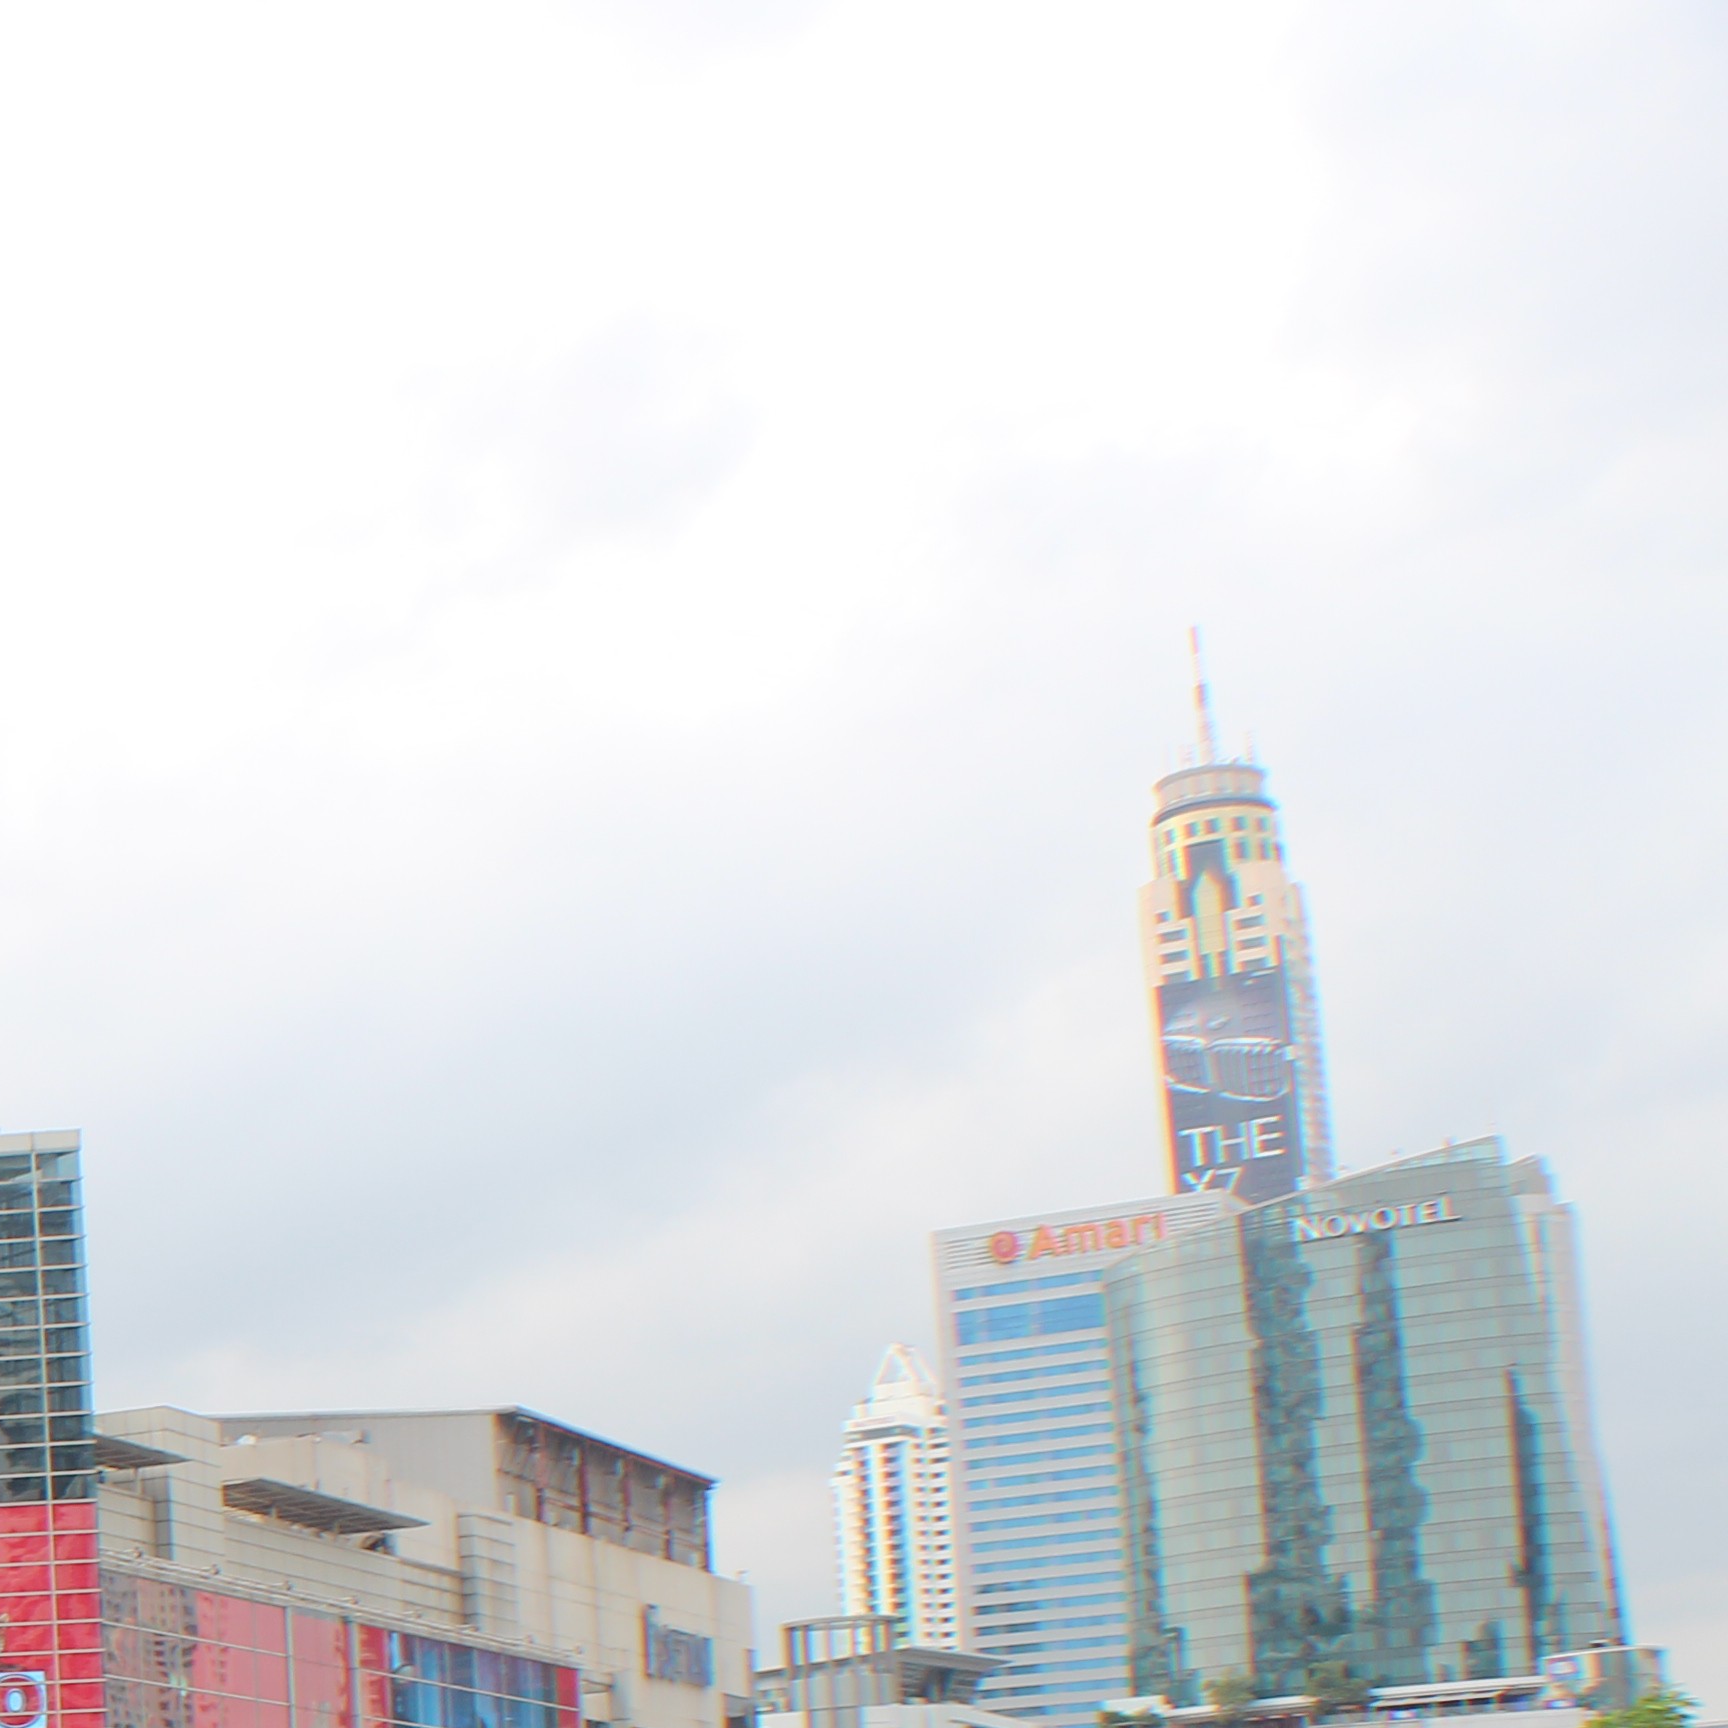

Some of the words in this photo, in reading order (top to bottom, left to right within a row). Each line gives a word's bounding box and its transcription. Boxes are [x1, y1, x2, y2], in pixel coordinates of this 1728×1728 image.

[1178, 1114, 1285, 1167] THE
[1028, 1211, 1167, 1260] Amari
[1294, 1196, 1461, 1243] NOVOTEL
